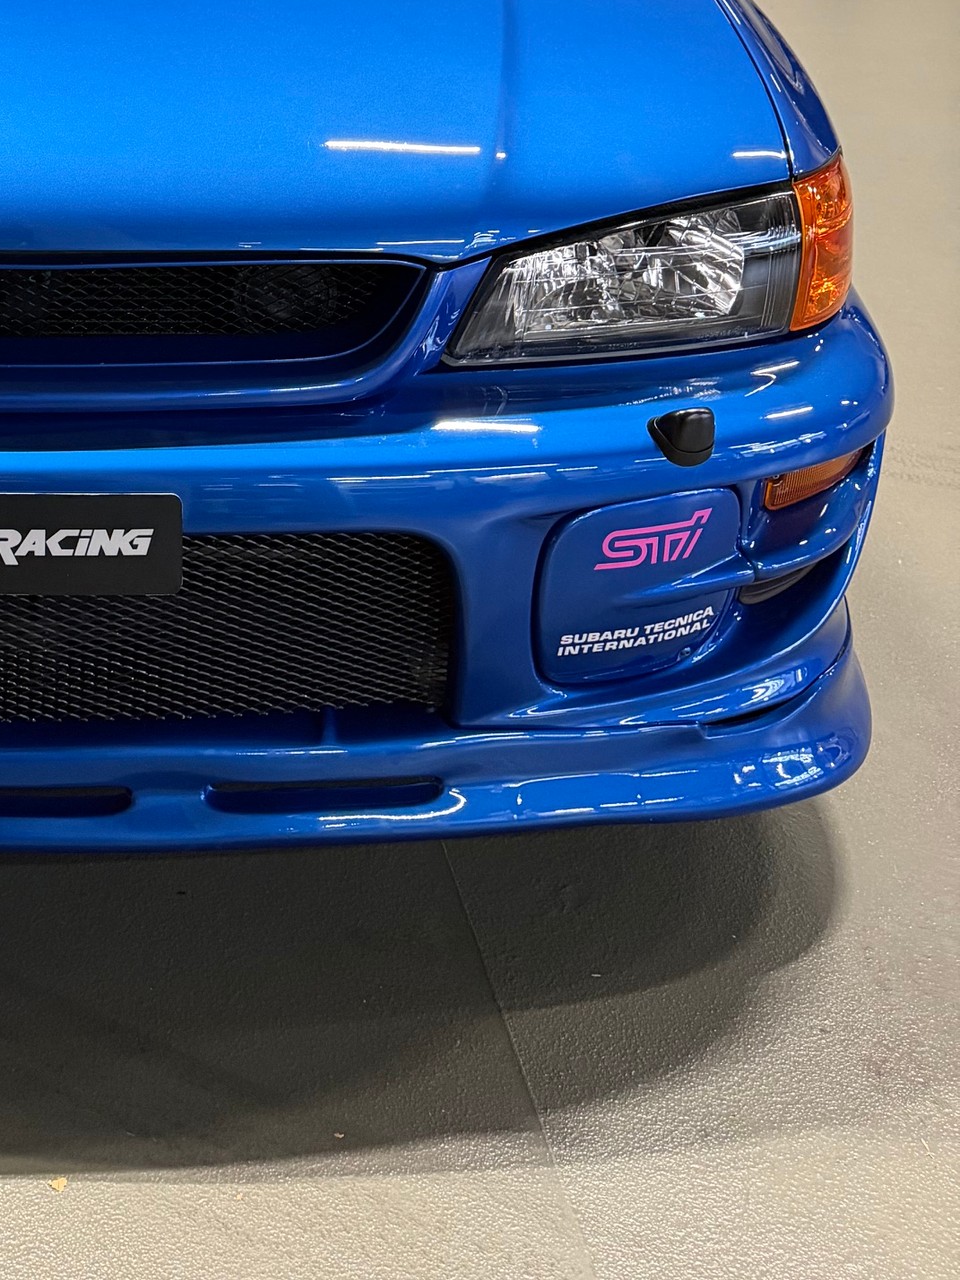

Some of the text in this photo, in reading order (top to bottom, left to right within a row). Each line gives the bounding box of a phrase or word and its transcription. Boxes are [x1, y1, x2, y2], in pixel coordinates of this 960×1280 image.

[556, 618, 711, 657] INTERNATIONAL
[560, 606, 715, 645] SUBARU TECNICA
